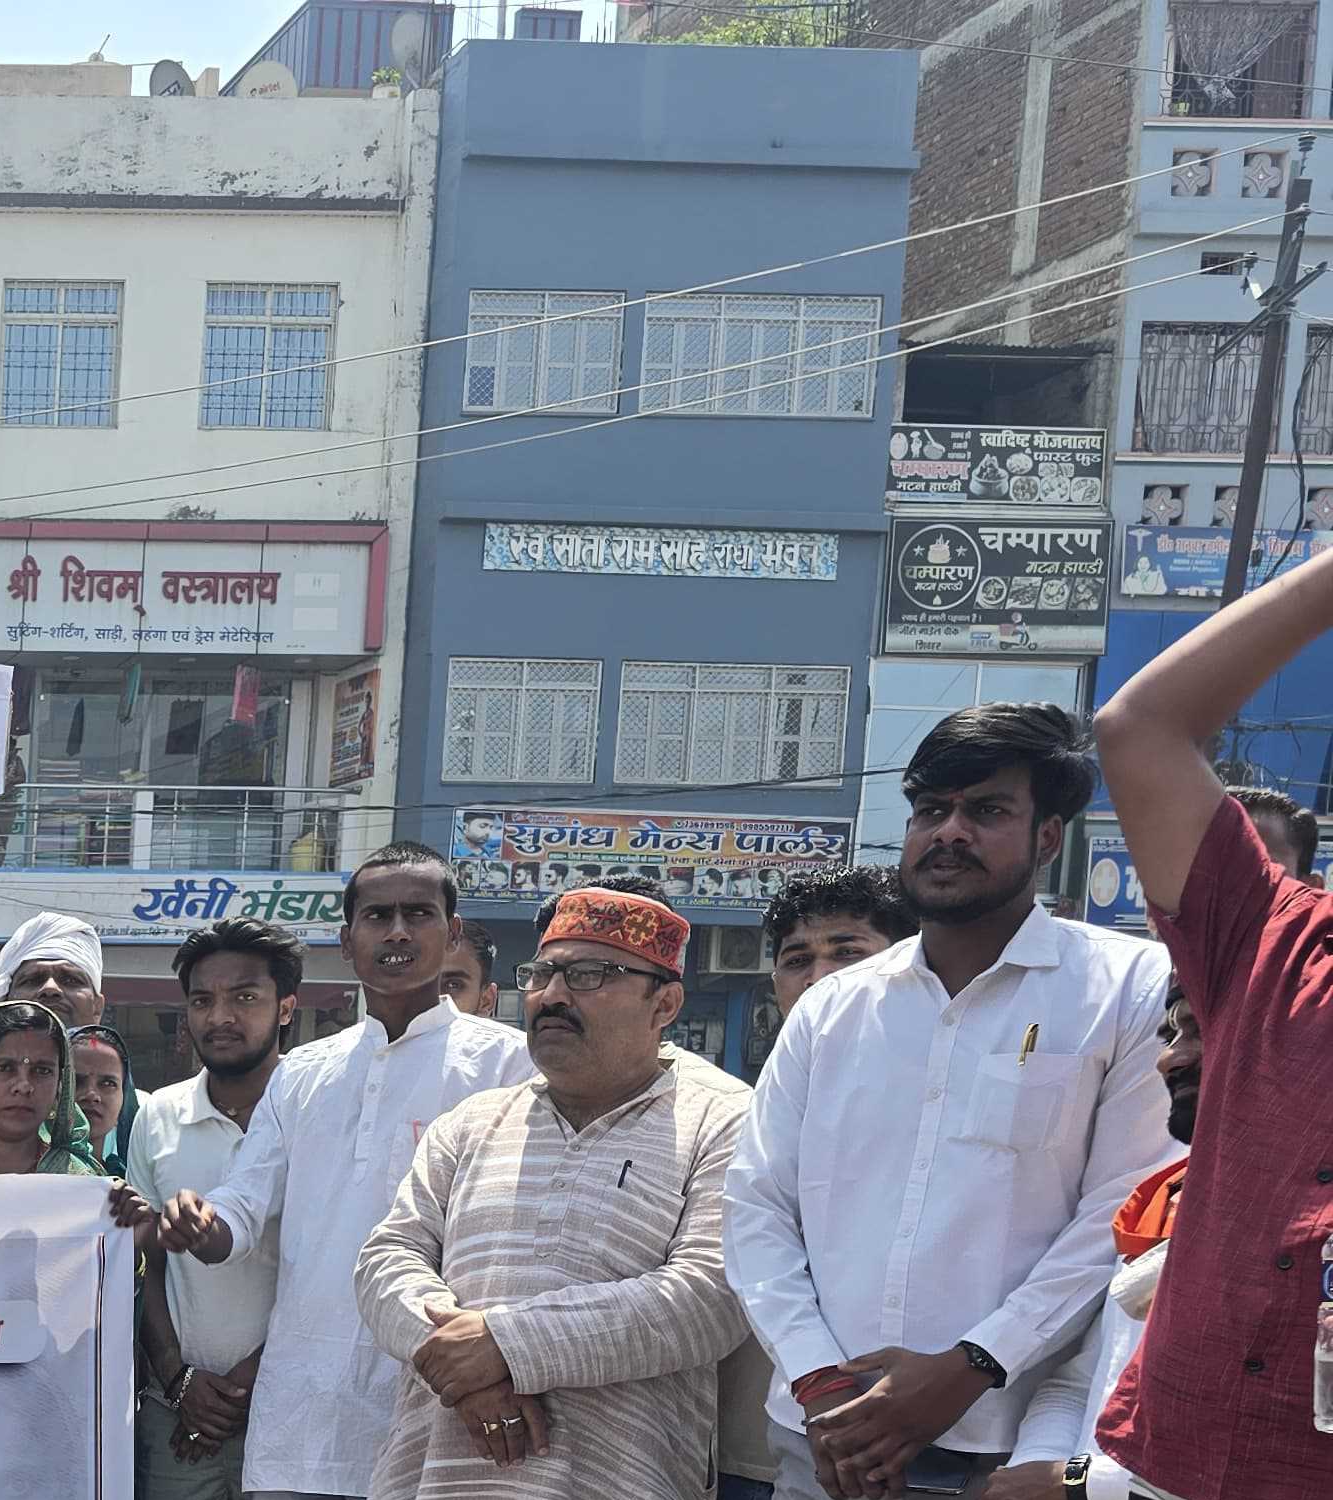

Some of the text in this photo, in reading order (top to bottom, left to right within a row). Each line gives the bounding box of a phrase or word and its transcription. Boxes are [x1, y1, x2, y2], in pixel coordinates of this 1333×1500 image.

[979, 430, 1031, 447] स्वादिष्ट
[1033, 431, 1103, 449] भोजनालय
[611, 534, 656, 571] राम
[760, 538, 819, 575] भवन
[978, 527, 1102, 556] चम्पारण
[904, 566, 975, 580] चम्पारण
[1025, 561, 1061, 574] मटन
[7, 554, 282, 617] श्री शिवम् वस्त्रालय
[132, 625, 167, 642] लहंगा
[172, 624, 190, 643] एवं
[195, 626, 215, 646] ड्रेस
[218, 626, 275, 645] मेटेरियल
[505, 819, 845, 859] सुगंध मेन्स पार्लर
[133, 877, 346, 923] खैनी भंडार
